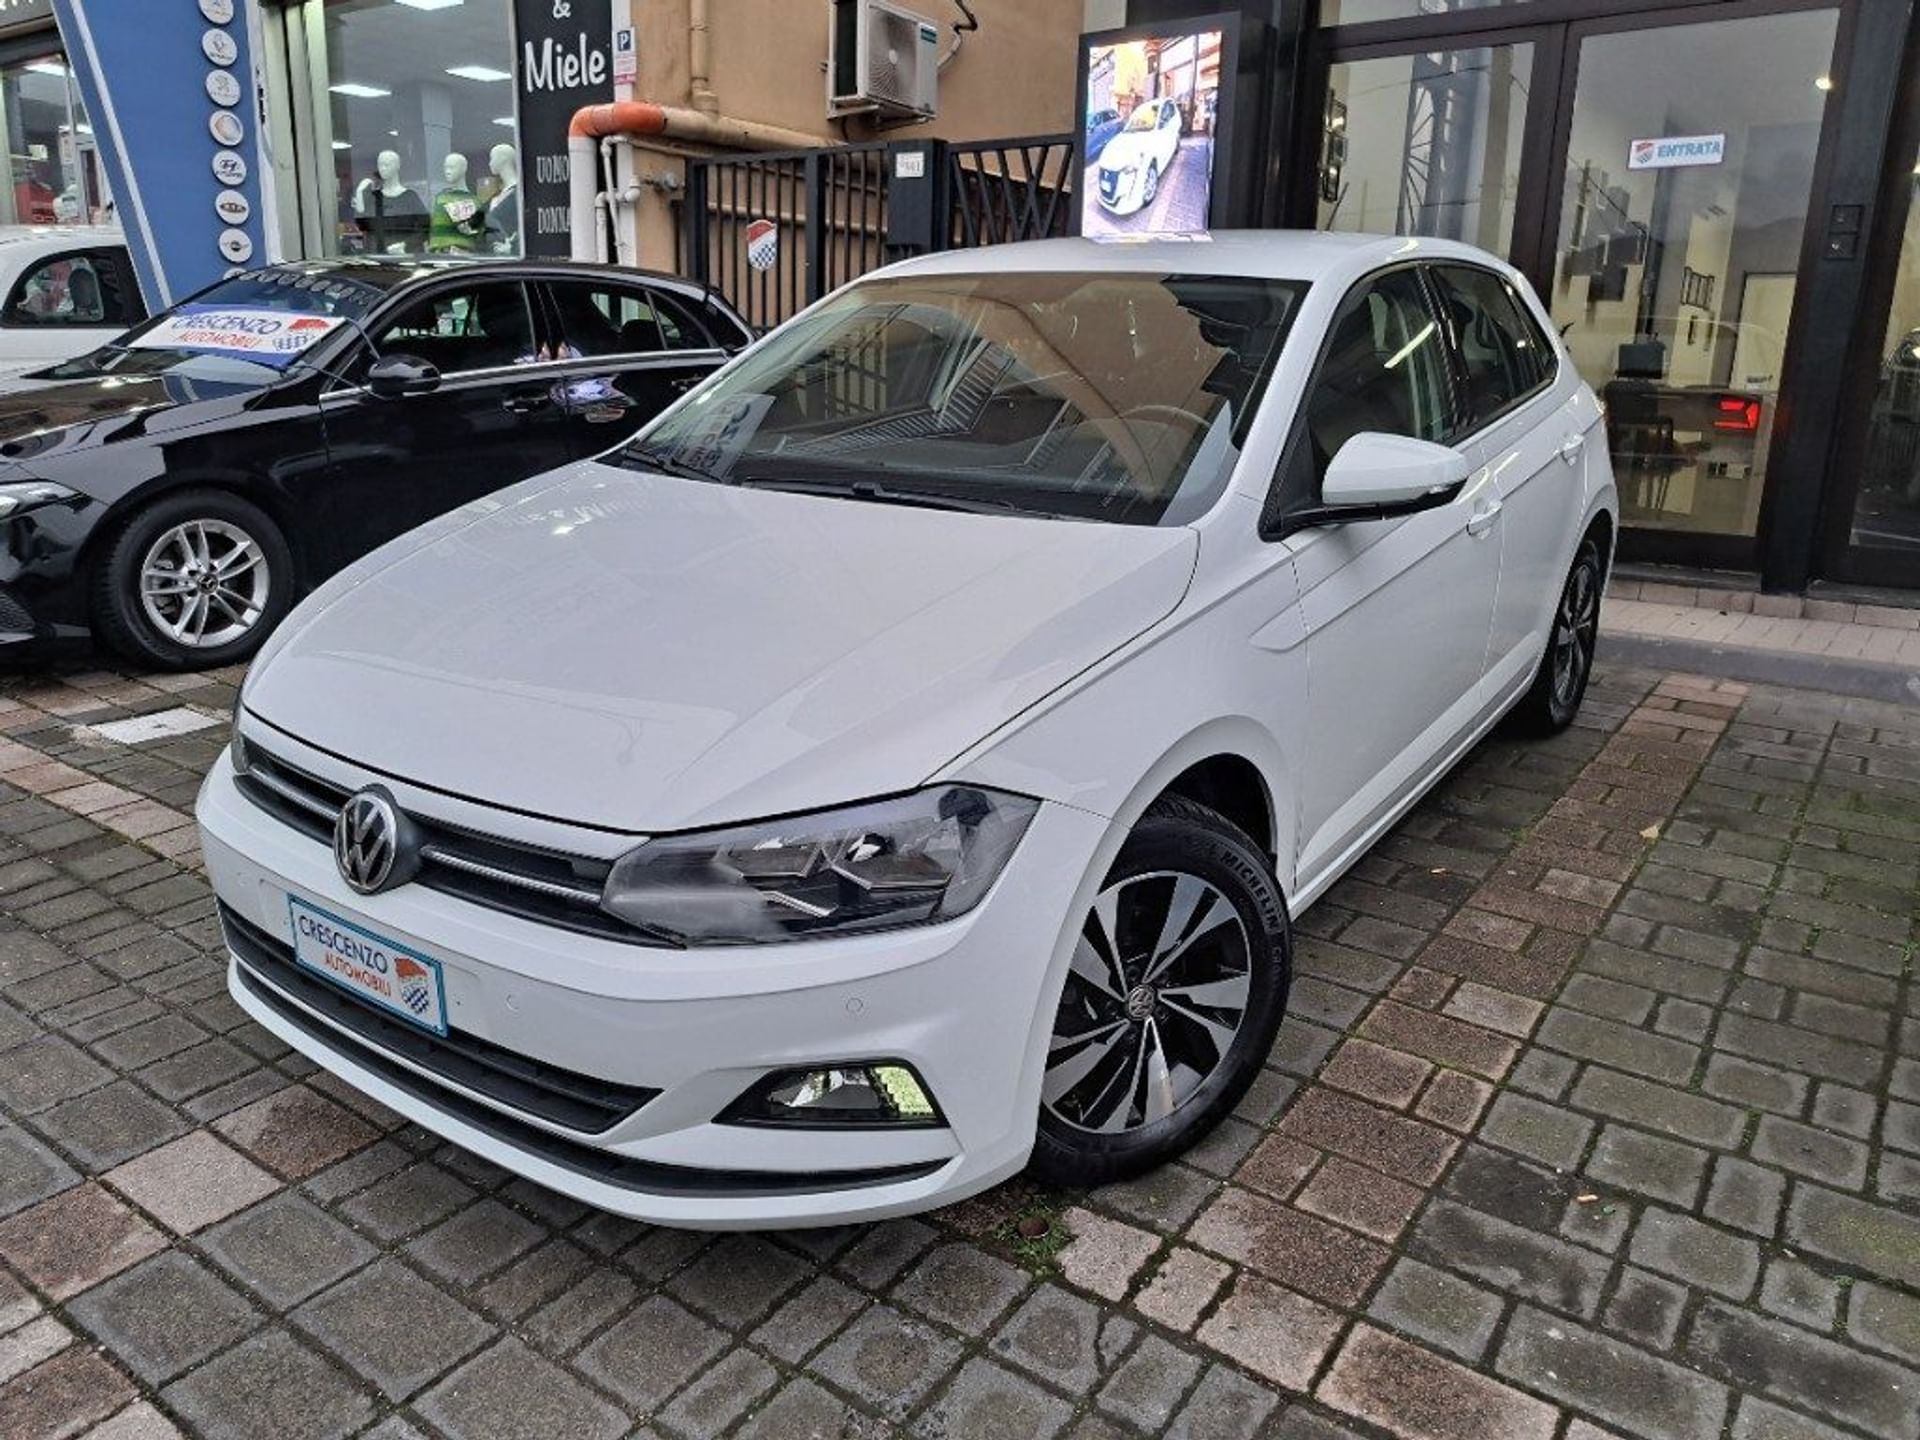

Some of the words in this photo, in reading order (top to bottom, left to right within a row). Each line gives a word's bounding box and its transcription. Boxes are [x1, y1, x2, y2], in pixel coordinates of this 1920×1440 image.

[525, 32, 606, 93] Miele
[1657, 141, 1721, 158] ENTRATA
[171, 315, 283, 335] CRESCENZO
[1220, 850, 1280, 933] MICHELIN
[299, 914, 388, 974] CRESCENZO
[325, 952, 392, 998] AUTOMOBILI
